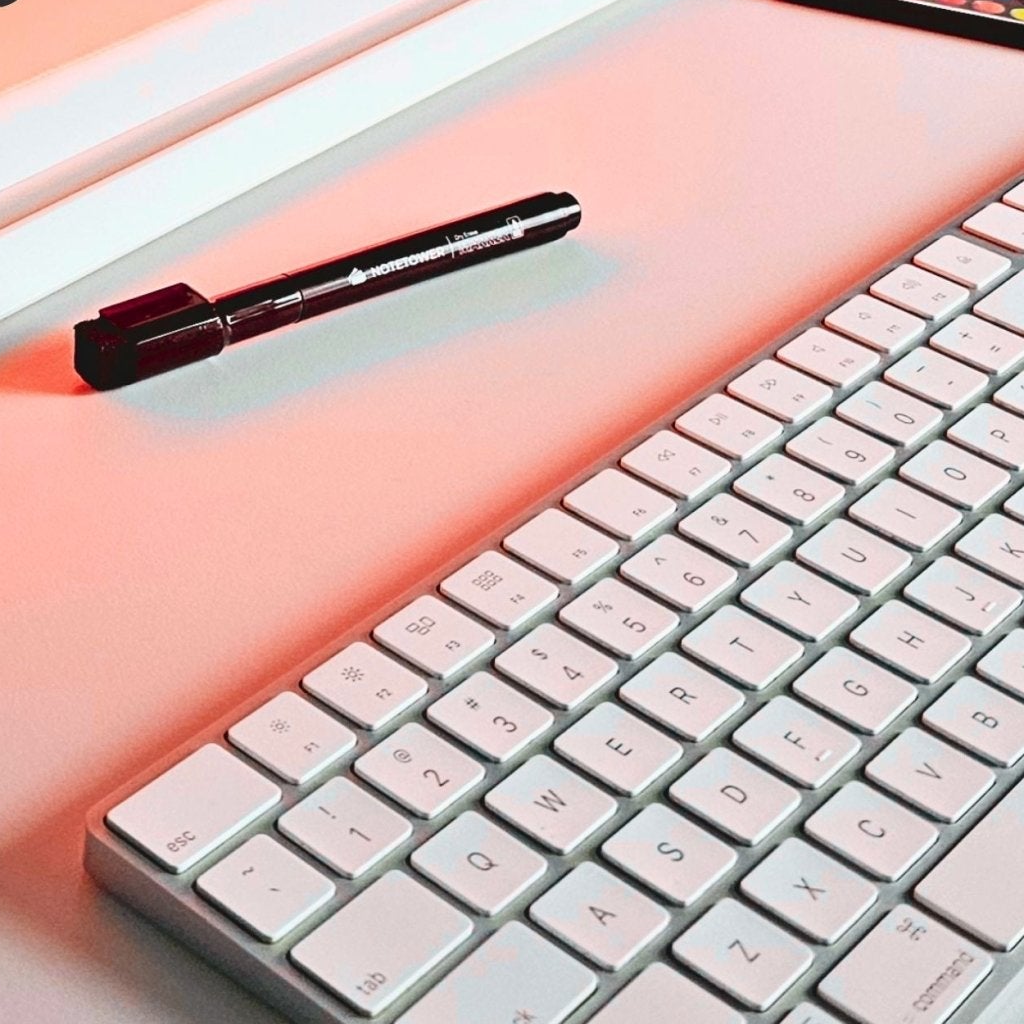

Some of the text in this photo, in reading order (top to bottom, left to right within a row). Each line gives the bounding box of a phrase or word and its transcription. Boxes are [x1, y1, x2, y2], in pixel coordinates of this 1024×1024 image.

[371, 246, 447, 278] NOTETOWER
[894, 413, 915, 424] 0
[990, 430, 1008, 442] P
[845, 450, 866, 462] 9
[689, 467, 701, 476] F7
[944, 468, 966, 480] O
[793, 489, 815, 501] 8
[711, 516, 728, 525] &
[738, 530, 758, 543] 7
[572, 549, 587, 558] F5
[842, 548, 867, 562] U
[1001, 543, 1024, 558] K
[683, 572, 705, 586] 6
[510, 594, 525, 604] F4
[787, 591, 810, 605] Y
[956, 587, 975, 601] J
[593, 601, 613, 613] %
[623, 618, 646, 632] 5
[445, 641, 460, 650] F3
[730, 637, 753, 652] T
[898, 631, 924, 648] H
[532, 649, 547, 660] $
[563, 666, 583, 680] 4
[376, 689, 391, 699] F2
[843, 680, 868, 696] G
[669, 687, 696, 704] R
[493, 716, 517, 732] 3
[972, 712, 998, 728] B
[304, 742, 319, 752] F1
[606, 738, 632, 756] E
[784, 731, 804, 749] F
[393, 749, 412, 763] @
[423, 769, 449, 787] 2
[916, 763, 942, 779] V
[534, 789, 566, 812] W
[720, 785, 747, 804] D
[318, 806, 336, 819] !
[349, 828, 371, 841] 1
[858, 820, 885, 838] C
[167, 828, 197, 853] esc
[657, 842, 684, 861] S
[467, 852, 498, 871] Q
[794, 878, 825, 900] X
[589, 906, 616, 925] A
[728, 939, 760, 962] Z
[355, 971, 387, 996] tab
[913, 951, 975, 1012] command
